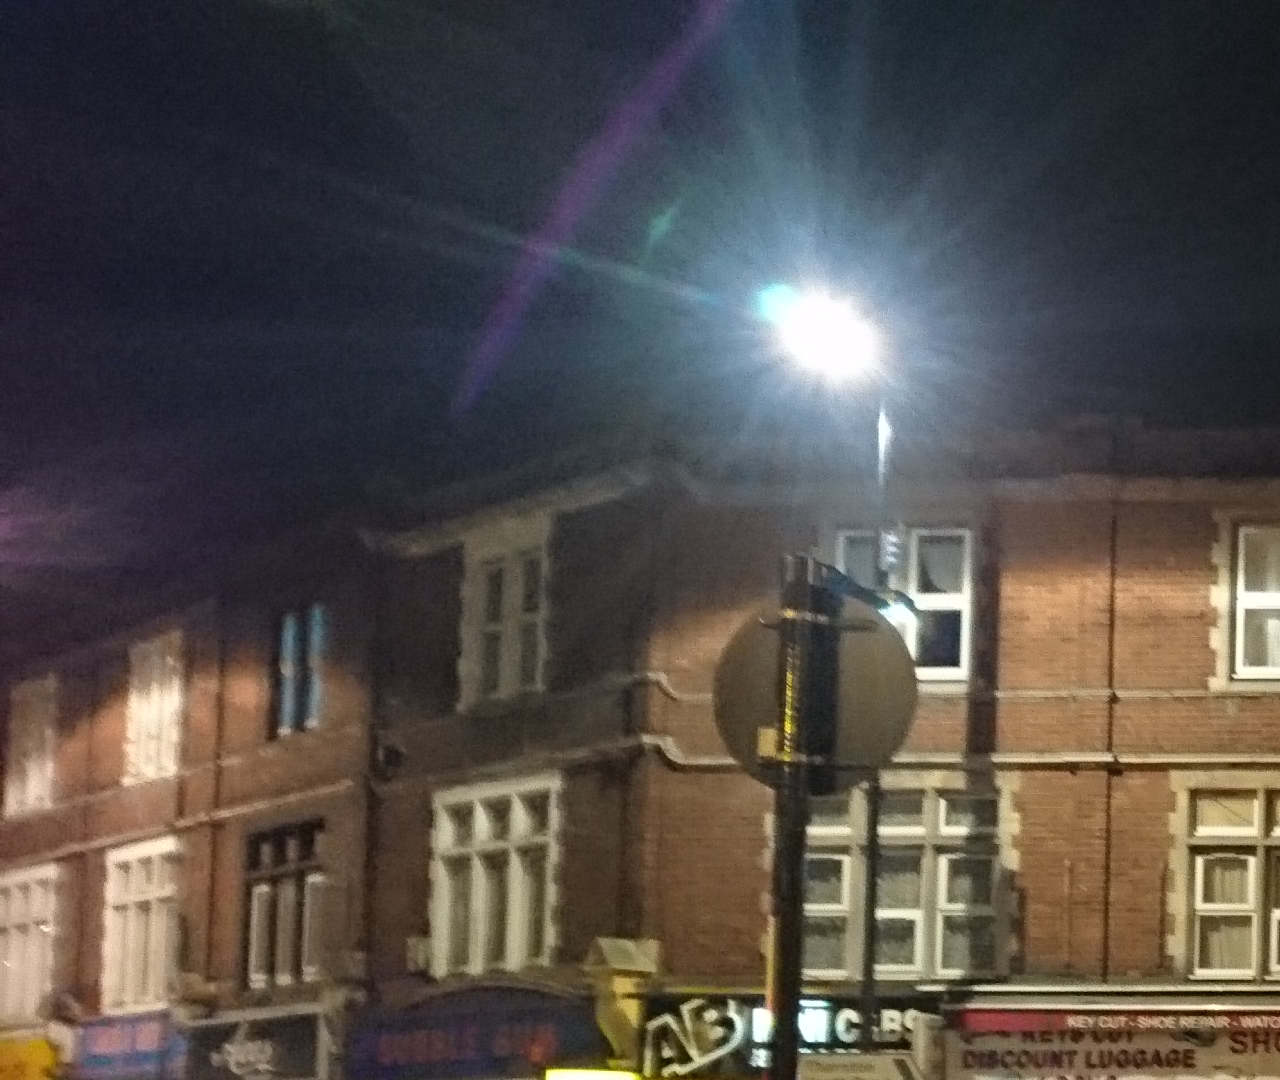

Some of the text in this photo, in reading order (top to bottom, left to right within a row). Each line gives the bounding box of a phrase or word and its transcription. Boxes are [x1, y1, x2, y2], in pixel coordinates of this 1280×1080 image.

[1066, 1015, 1094, 1028] KEY
[1098, 1015, 1128, 1028] CUT
[1137, 1015, 1176, 1029] SHOE
[1179, 1016, 1231, 1029] REPAIR
[962, 1050, 1197, 1069] DISCOUNT LUGGAGE
